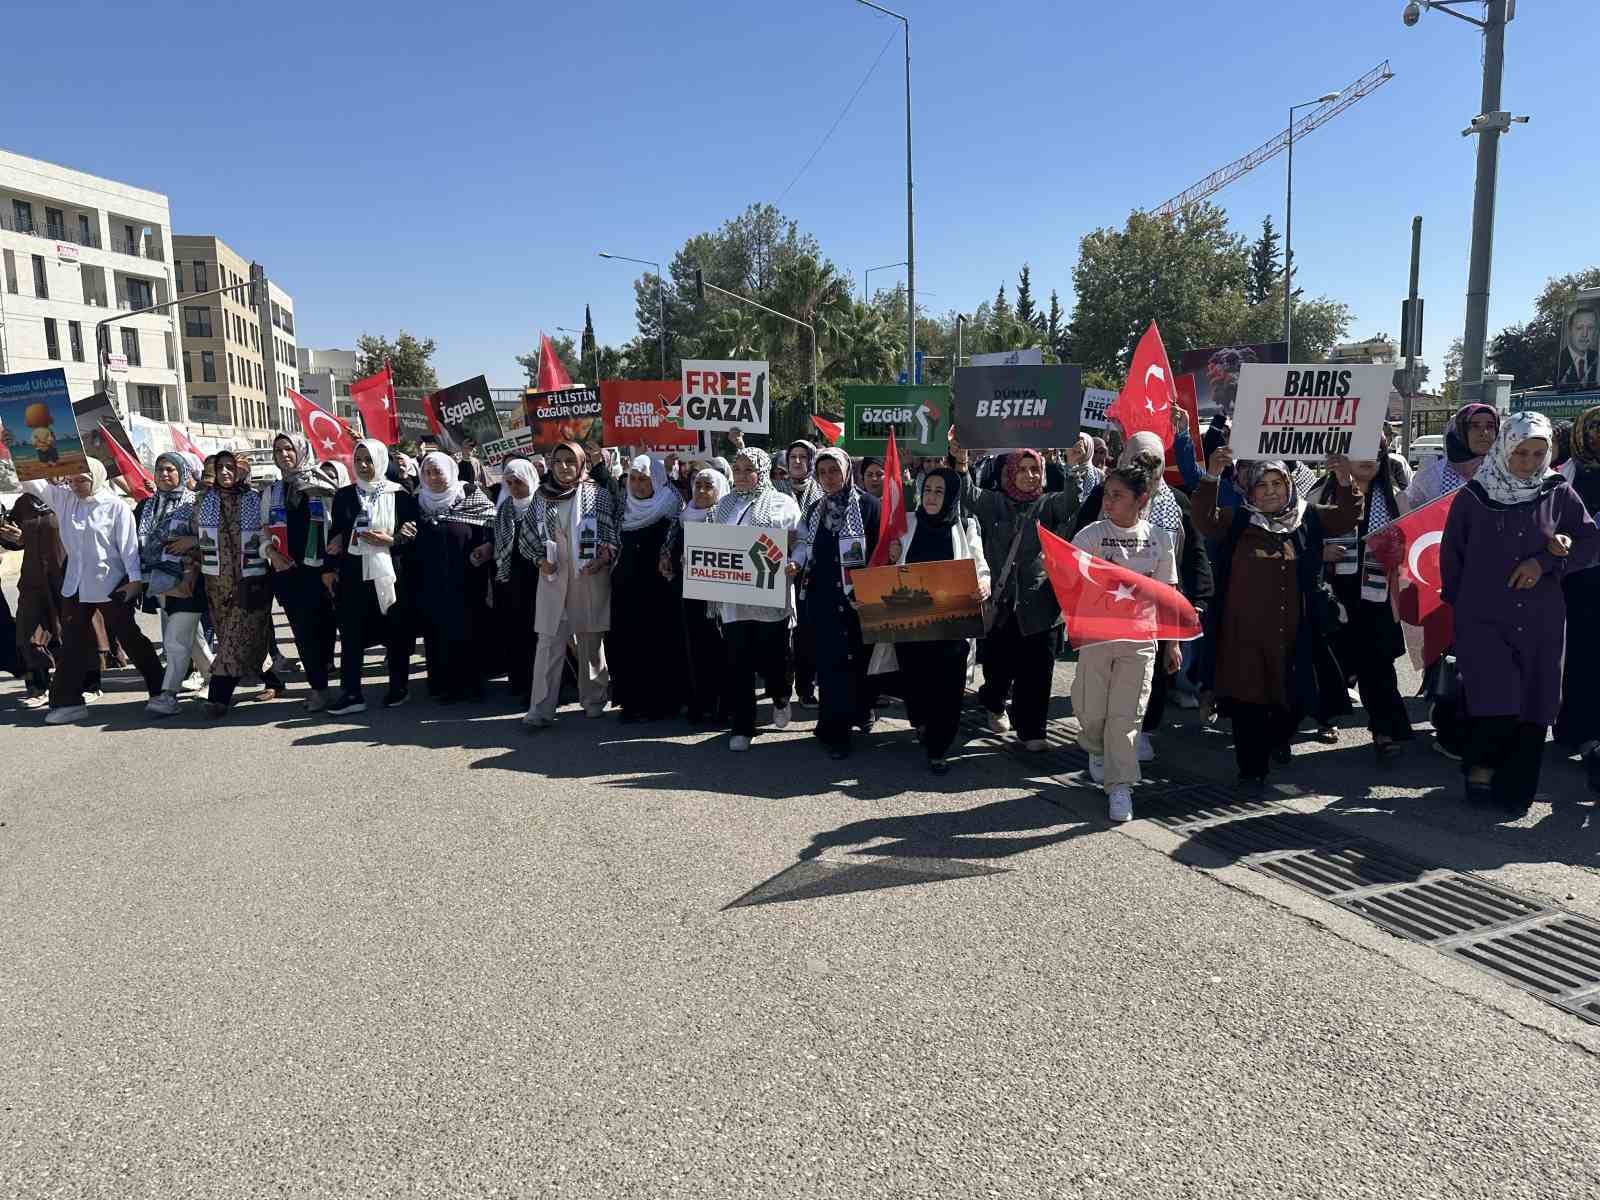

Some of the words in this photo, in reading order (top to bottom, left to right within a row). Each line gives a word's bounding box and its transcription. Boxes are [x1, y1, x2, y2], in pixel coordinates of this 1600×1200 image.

[685, 371, 751, 396] FREE
[1284, 370, 1352, 401] BARIŞ
[547, 390, 596, 405] FİLİSTİN
[440, 395, 486, 425] İşgale
[537, 407, 570, 418] ÖZGÜR
[572, 403, 602, 415] OLACA
[618, 402, 655, 415] ÖZGÜR
[686, 397, 754, 422] GAZA
[862, 407, 913, 423] ÖZGÜR
[975, 399, 1048, 420] BEŞTEN
[1267, 400, 1353, 424] KADINLA
[614, 414, 660, 428] FİLİSTİN
[484, 438, 516, 455] FREE
[1258, 427, 1353, 455] MÜMKÜN
[691, 550, 744, 570] FREE
[691, 568, 752, 582] PALESTINE
